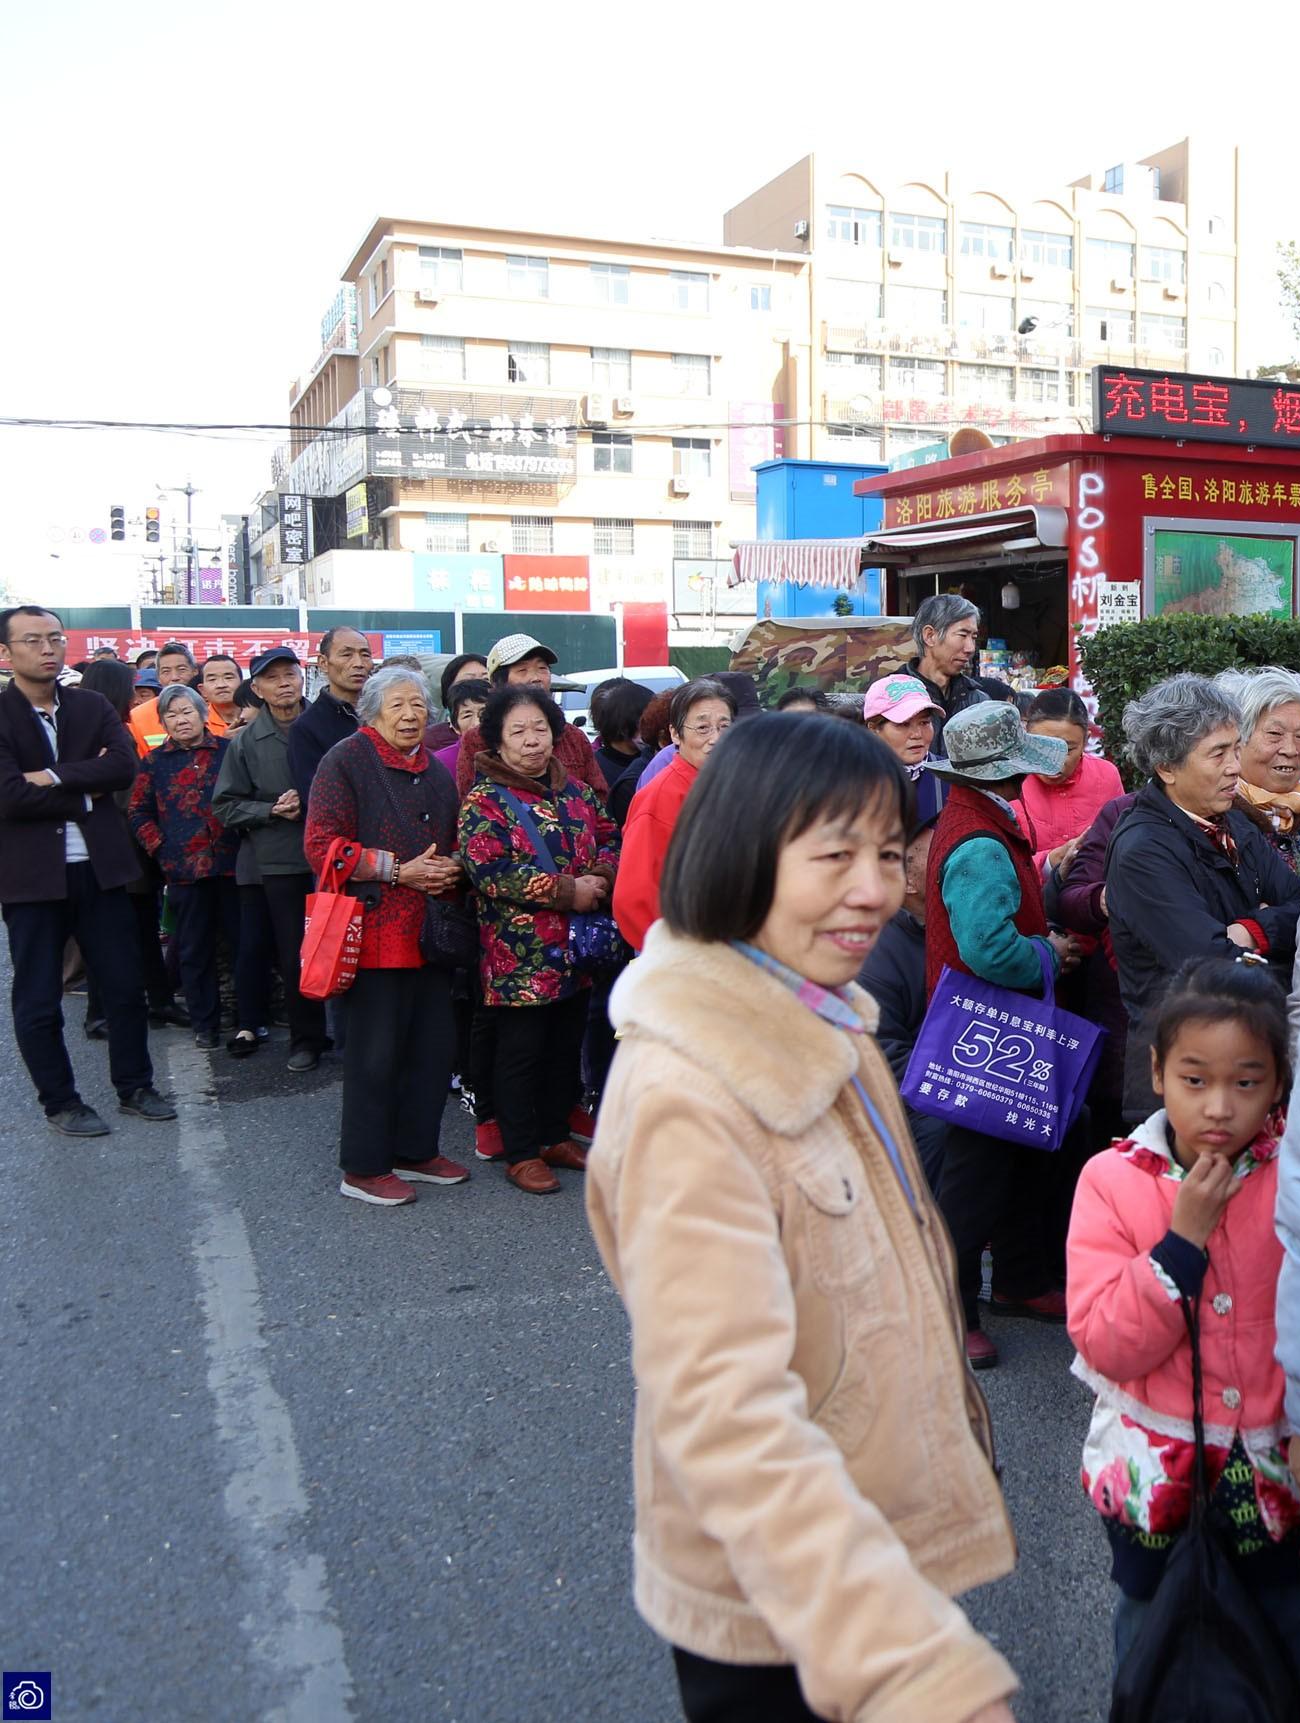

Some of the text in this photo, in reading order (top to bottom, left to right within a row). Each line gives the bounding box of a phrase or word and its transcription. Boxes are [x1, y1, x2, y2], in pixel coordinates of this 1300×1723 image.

[895, 468, 1053, 524] 洛阳旅游服务亭
[284, 495, 303, 562] 网吧密室
[1100, 594, 1138, 607] 刘金宝
